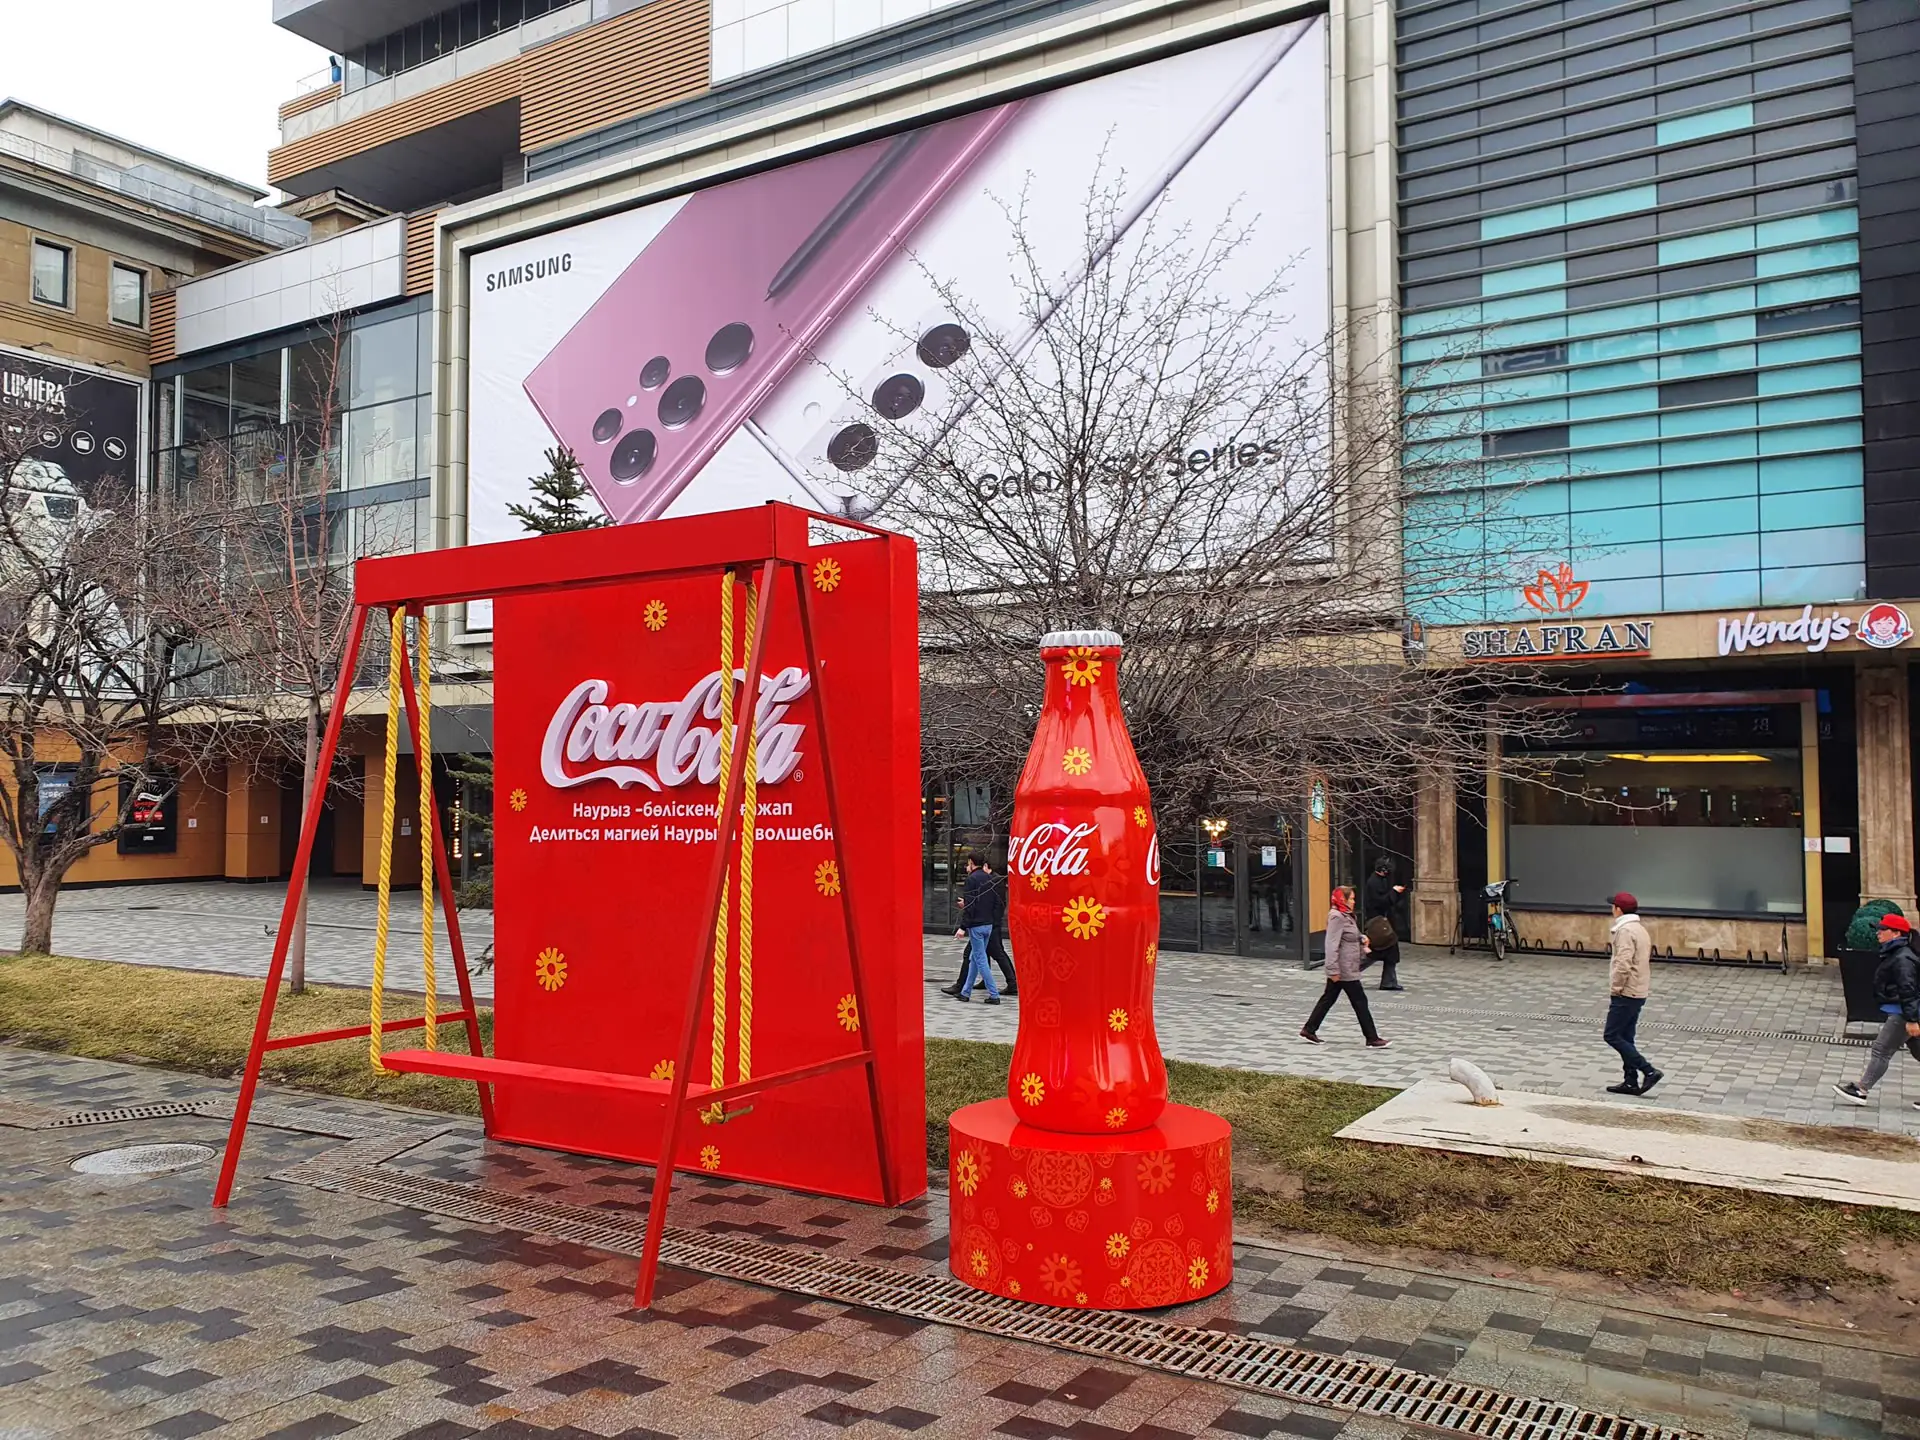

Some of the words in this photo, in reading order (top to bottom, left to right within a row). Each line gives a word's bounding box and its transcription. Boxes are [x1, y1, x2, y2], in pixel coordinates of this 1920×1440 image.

[486, 252, 572, 293] SAMSUNG
[1462, 620, 1653, 657] SHAFRAN
[1718, 604, 1850, 656] Wendy's
[541, 666, 816, 792] Coca-Cola
[573, 802, 631, 820] Наурыз
[739, 802, 793, 816] ғжап
[530, 825, 600, 843] Делиться
[604, 824, 660, 841] магией
[664, 825, 737, 844] Науры
[755, 823, 834, 841] волшебн
